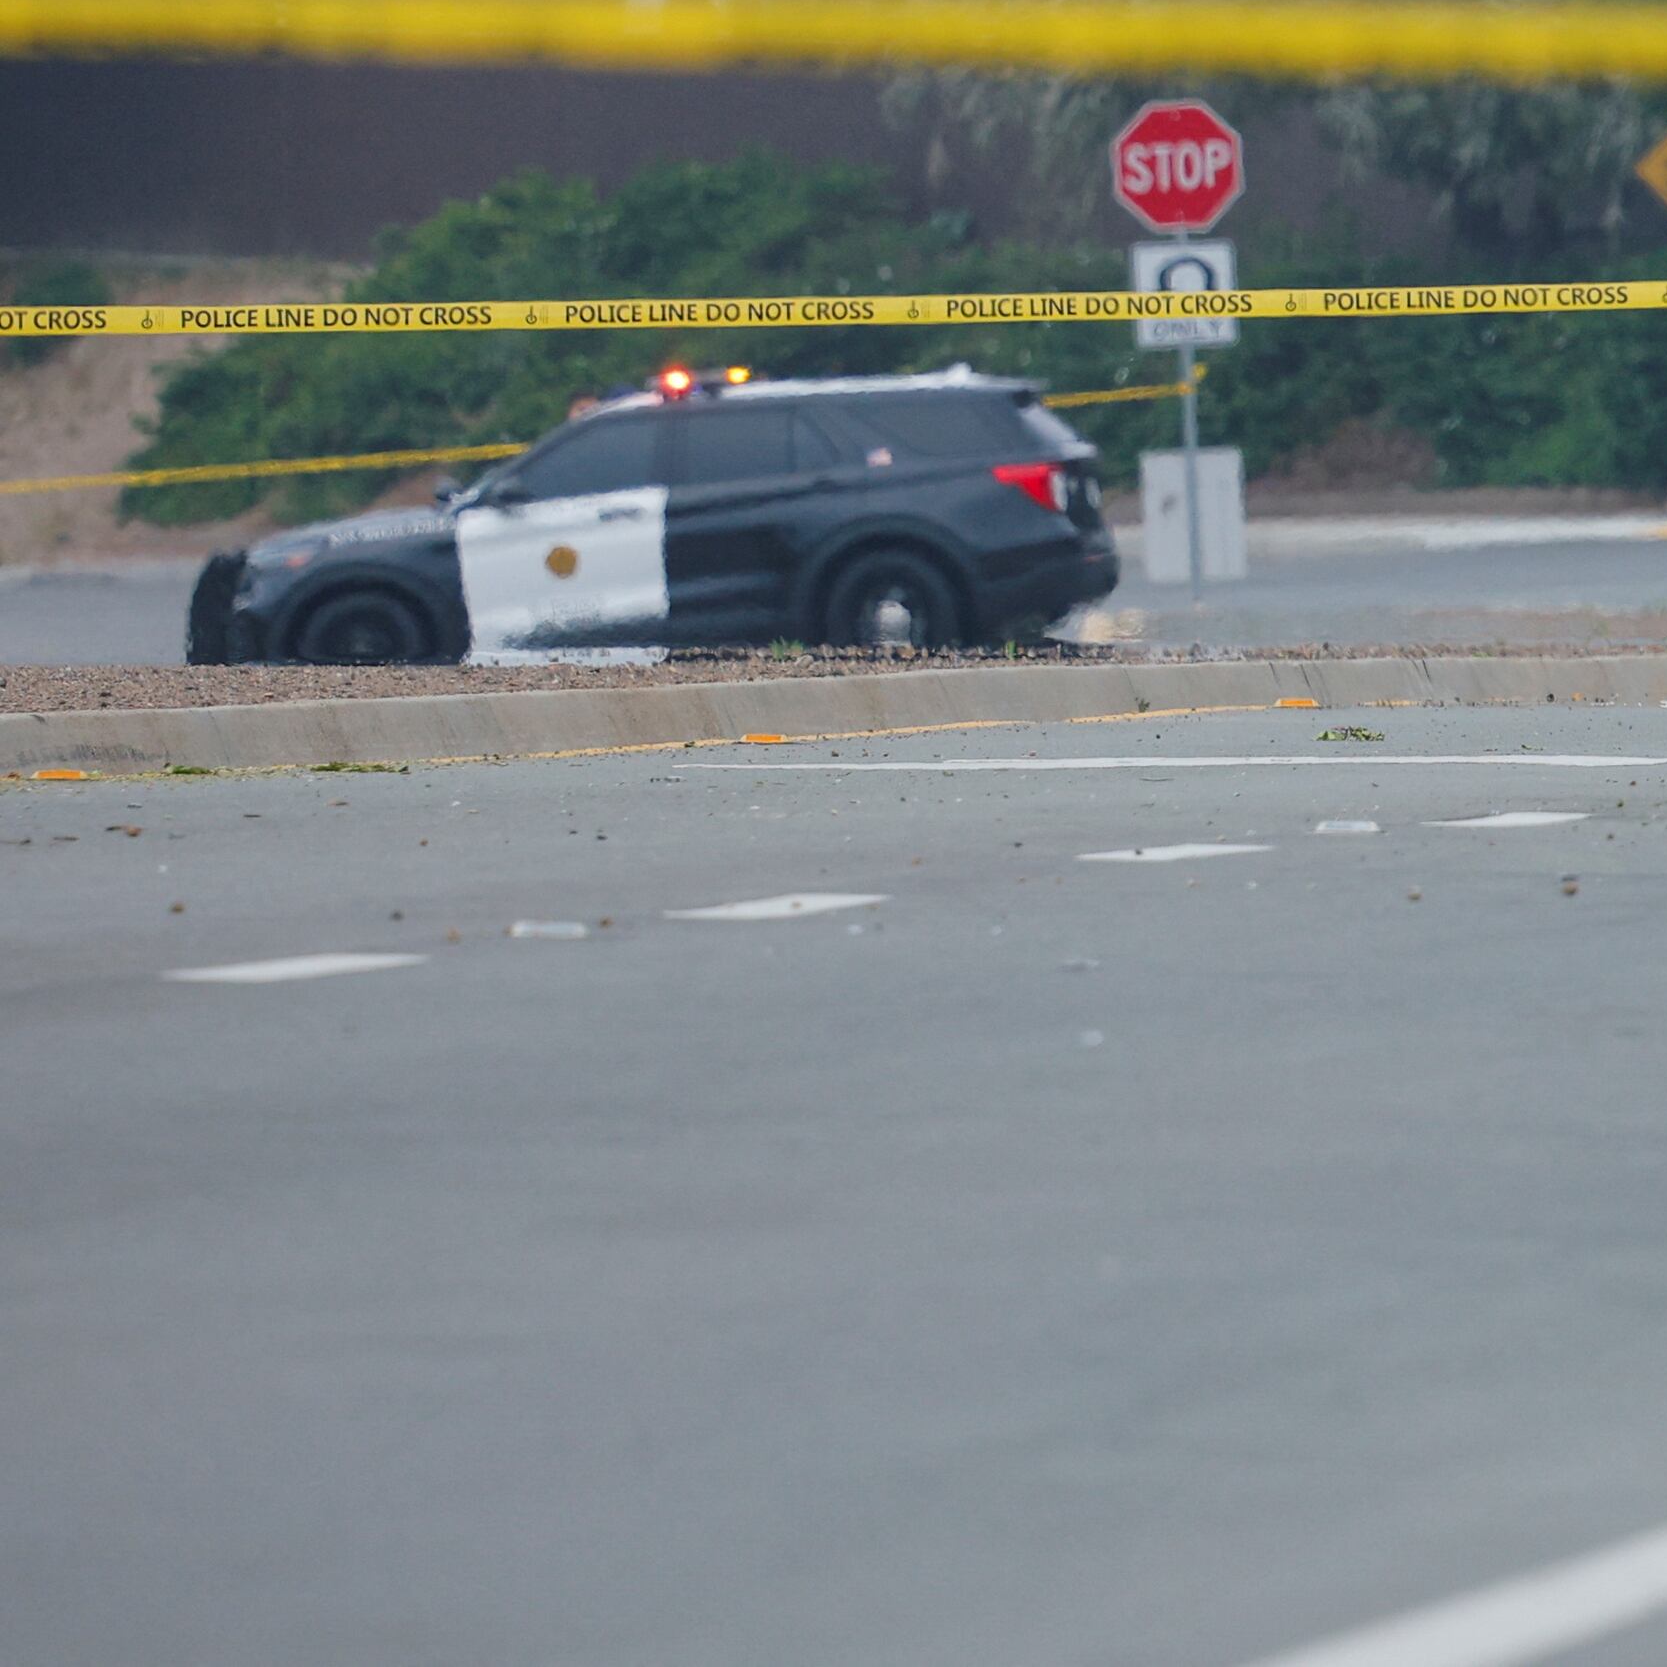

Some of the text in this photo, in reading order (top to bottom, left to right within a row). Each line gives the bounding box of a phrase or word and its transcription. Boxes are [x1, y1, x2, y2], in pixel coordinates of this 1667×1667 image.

[1124, 138, 1233, 196] STOP
[945, 294, 1253, 318] POLICE LINE DO NOT CROSS
[1322, 285, 1629, 311] POLICE LINE DO NOT CROSS
[0, 310, 107, 330] OT CROSS
[180, 305, 493, 328] POLICE LINE DO NOT CROSS
[564, 301, 875, 323] POLICE LINE DO NOT CROSS
[1154, 321, 1221, 340] ONLY
